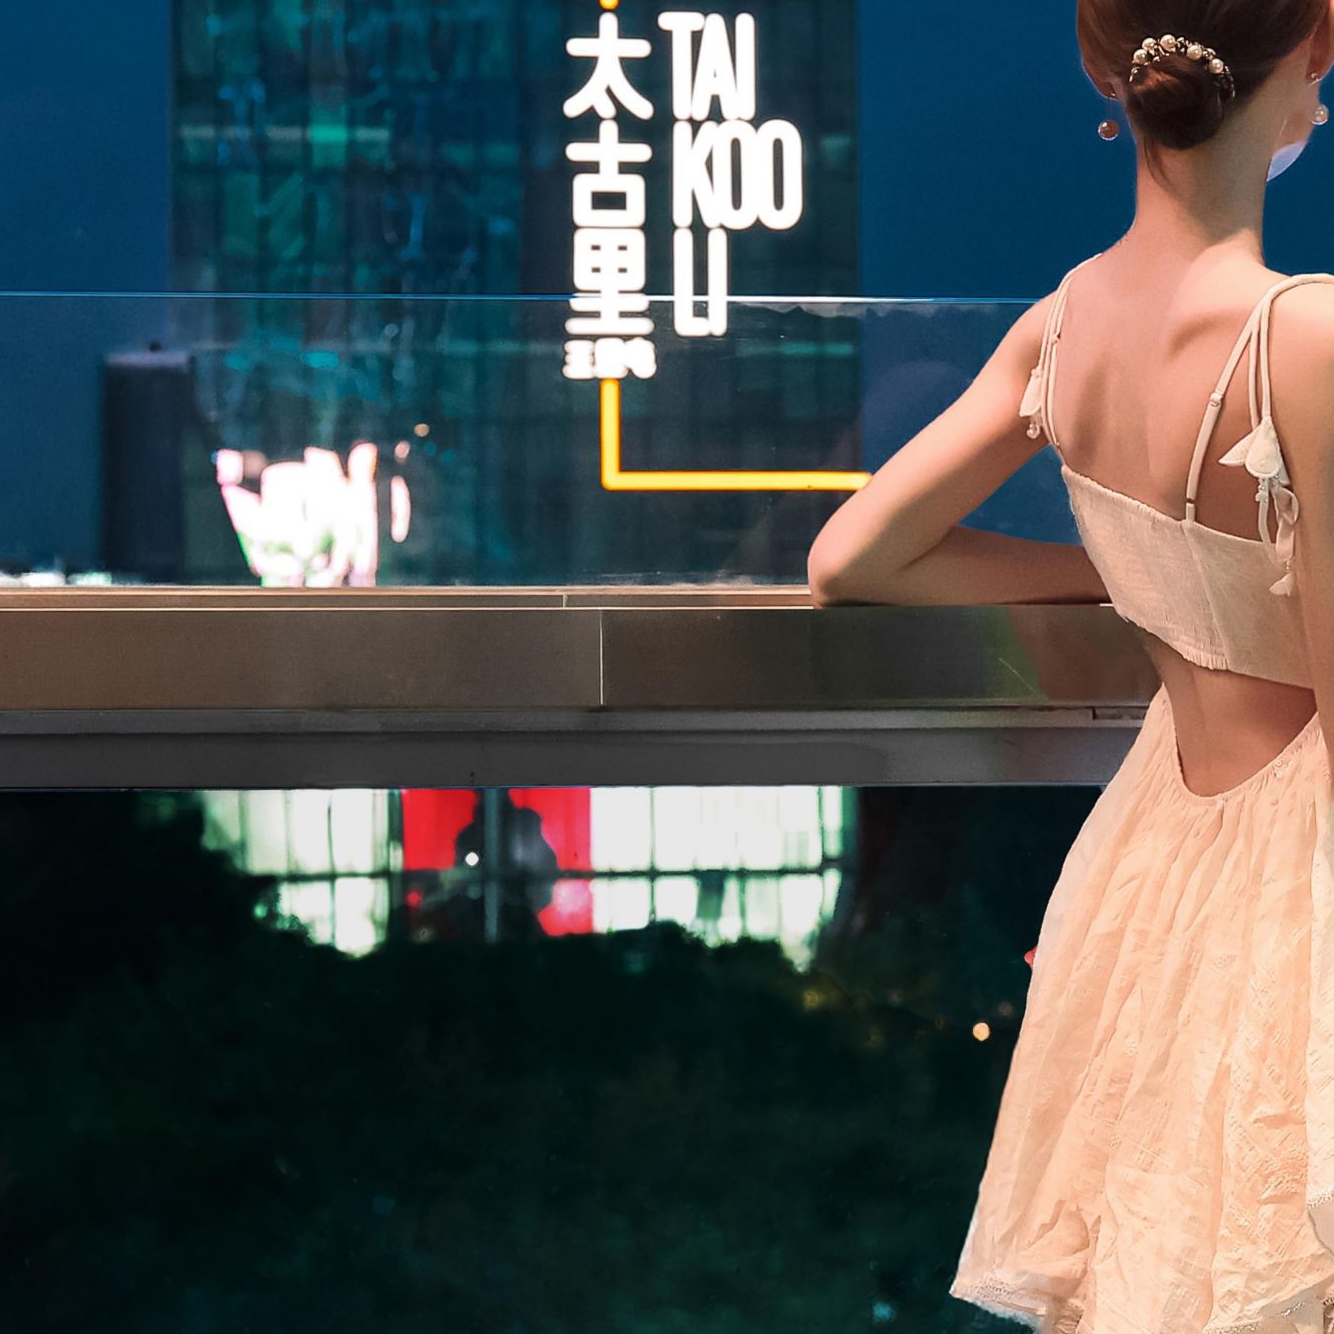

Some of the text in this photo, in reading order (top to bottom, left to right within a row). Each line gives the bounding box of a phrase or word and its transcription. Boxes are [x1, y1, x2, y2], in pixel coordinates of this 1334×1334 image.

[658, 12, 756, 121] TAI
[563, 12, 655, 335] 太古里
[673, 119, 803, 230] KOO
[673, 228, 728, 337] LI
